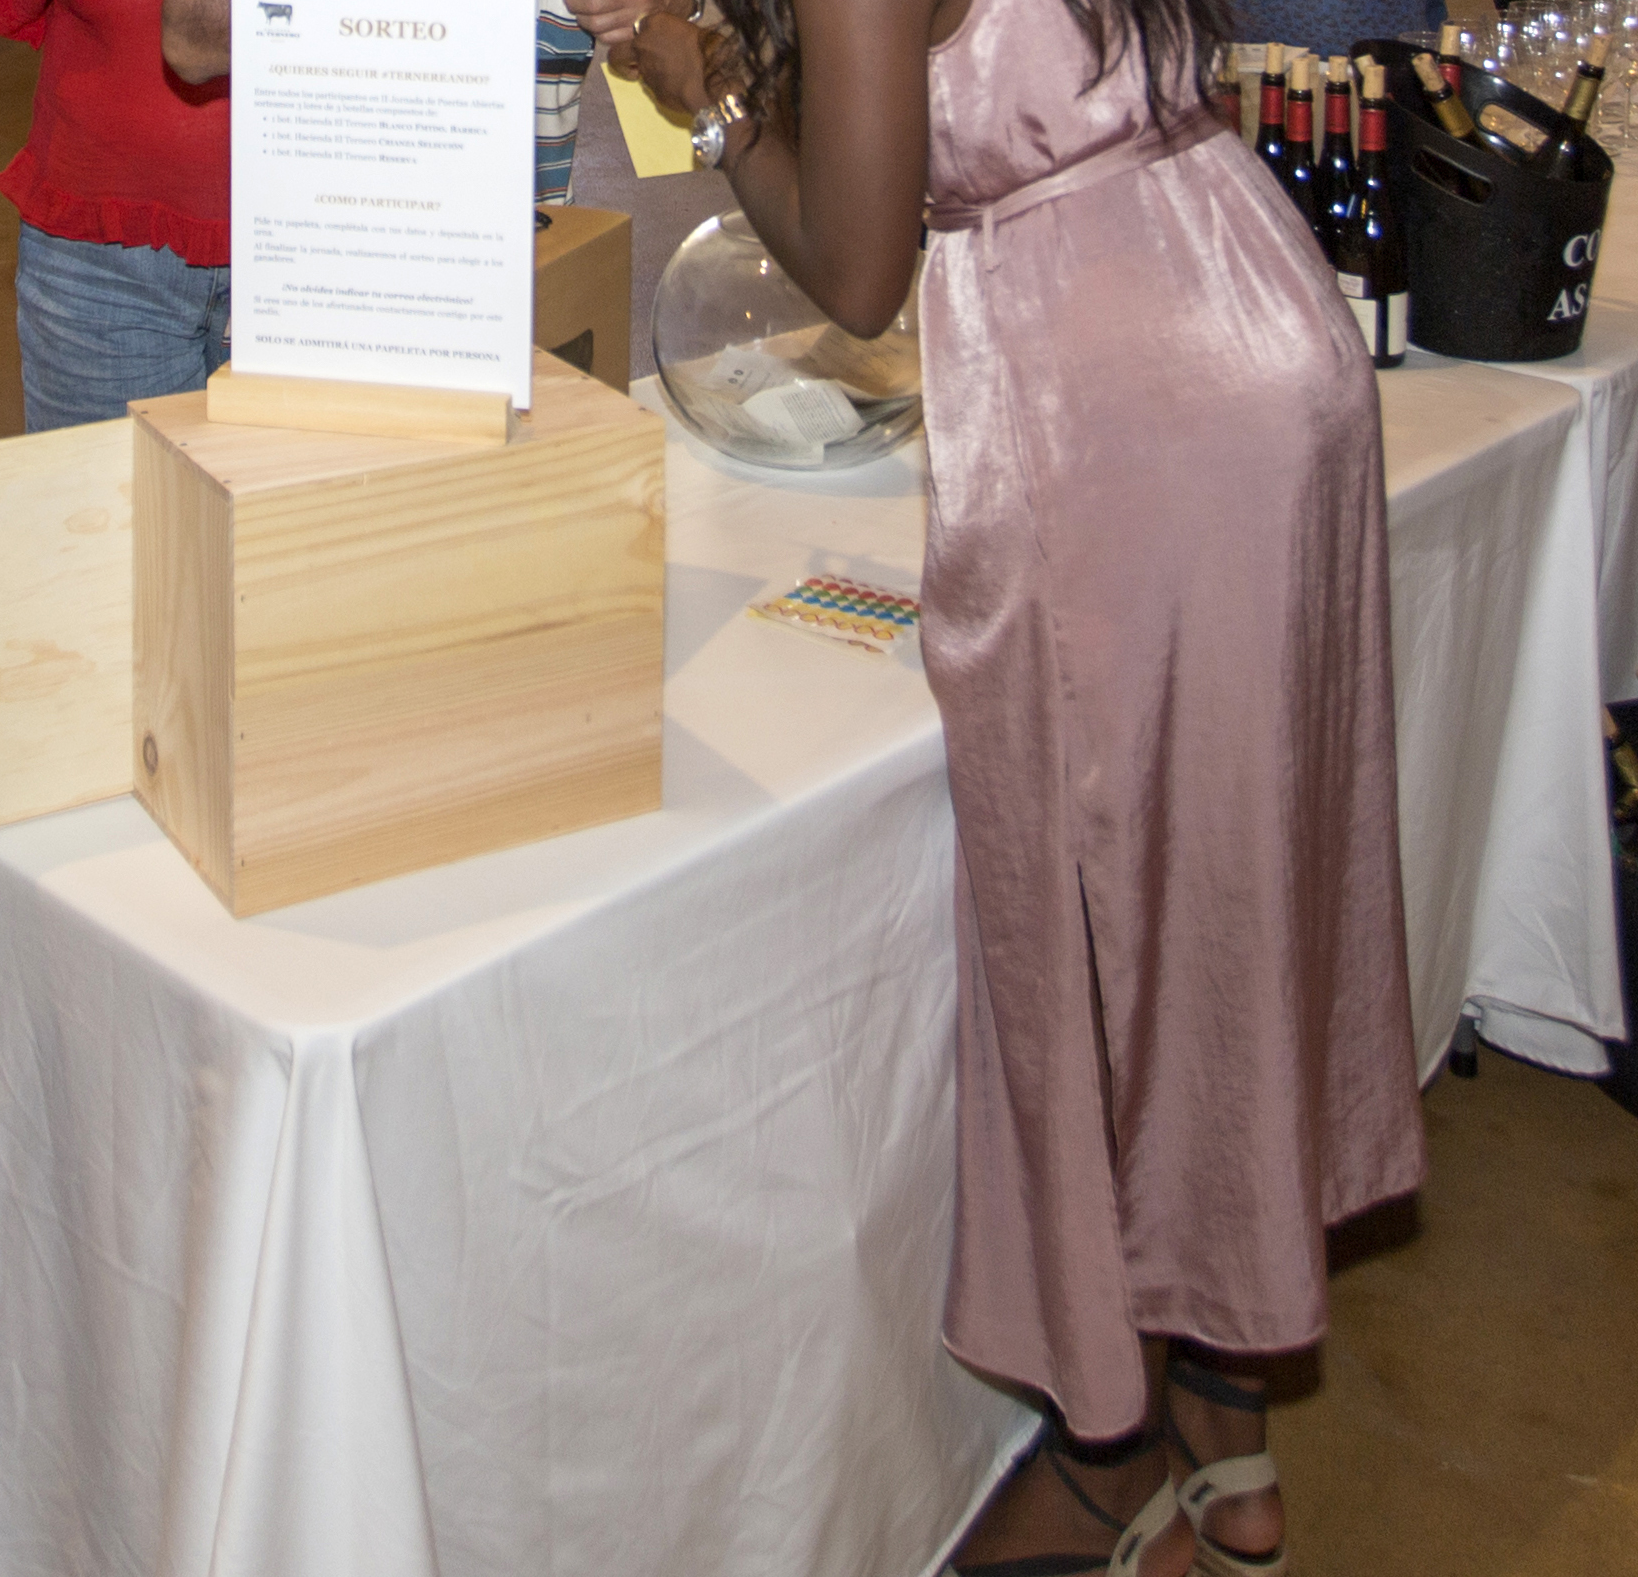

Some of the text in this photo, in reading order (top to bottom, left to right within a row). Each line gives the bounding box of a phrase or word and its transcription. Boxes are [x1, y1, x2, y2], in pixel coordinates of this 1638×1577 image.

[338, 17, 447, 42] SORTEO
[269, 64, 490, 85] ¿QUIERES SEGUIR #TERNEREANDO?
[254, 88, 276, 97] Entre
[278, 89, 300, 97] todos
[302, 90, 313, 98] los
[315, 91, 367, 101] participantes
[390, 95, 423, 105] Jornada
[425, 97, 435, 105] de
[437, 98, 468, 107] Puertas
[471, 99, 504, 109] Abiertas
[254, 101, 294, 109] sorteamos
[303, 102, 322, 110] lotes
[324, 103, 334, 111] de
[343, 104, 374, 113] botellas
[376, 107, 423, 116] compuestos
[295, 116, 332, 126] Hacienda
[334, 118, 343, 127] El
[345, 119, 377, 128] Ternero
[295, 133, 332, 143] Hacienda
[334, 135, 343, 143] El
[345, 135, 377, 145] Ternero
[295, 149, 332, 159] Hacienda
[334, 151, 343, 160] El
[345, 152, 377, 161] Ternero
[379, 154, 417, 164] RESERVA
[360, 196, 441, 211] PARTICIPAR?
[254, 216, 271, 225] Pide
[405, 226, 426, 236] datos
[496, 232, 504, 241] la
[254, 242, 262, 250] Al
[265, 242, 297, 252] finalizar
[300, 245, 307, 253] la
[345, 249, 396, 259] realizaremos
[399, 252, 407, 260] el
[410, 254, 434, 262] sorteo
[437, 256, 455, 264] para
[458, 256, 480, 267] elegir
[491, 257, 503, 267] los
[300, 285, 333, 295] olvides
[335, 287, 370, 297] indicar
[372, 290, 381, 298] tu
[383, 292, 415, 301] correo
[1546, 283, 1590, 321] AS
[254, 295, 261, 303] Si
[300, 299, 309, 307] de
[312, 299, 323, 308] los
[326, 300, 374, 311] afortunados
[376, 306, 434, 316] contactaremos
[437, 310, 467, 320] contigo
[470, 313, 484, 321] por
[486, 314, 503, 322] este
[255, 334, 501, 362] SOLO SE ADMITIRÁ UNA PAPELETA POR PERSONA
